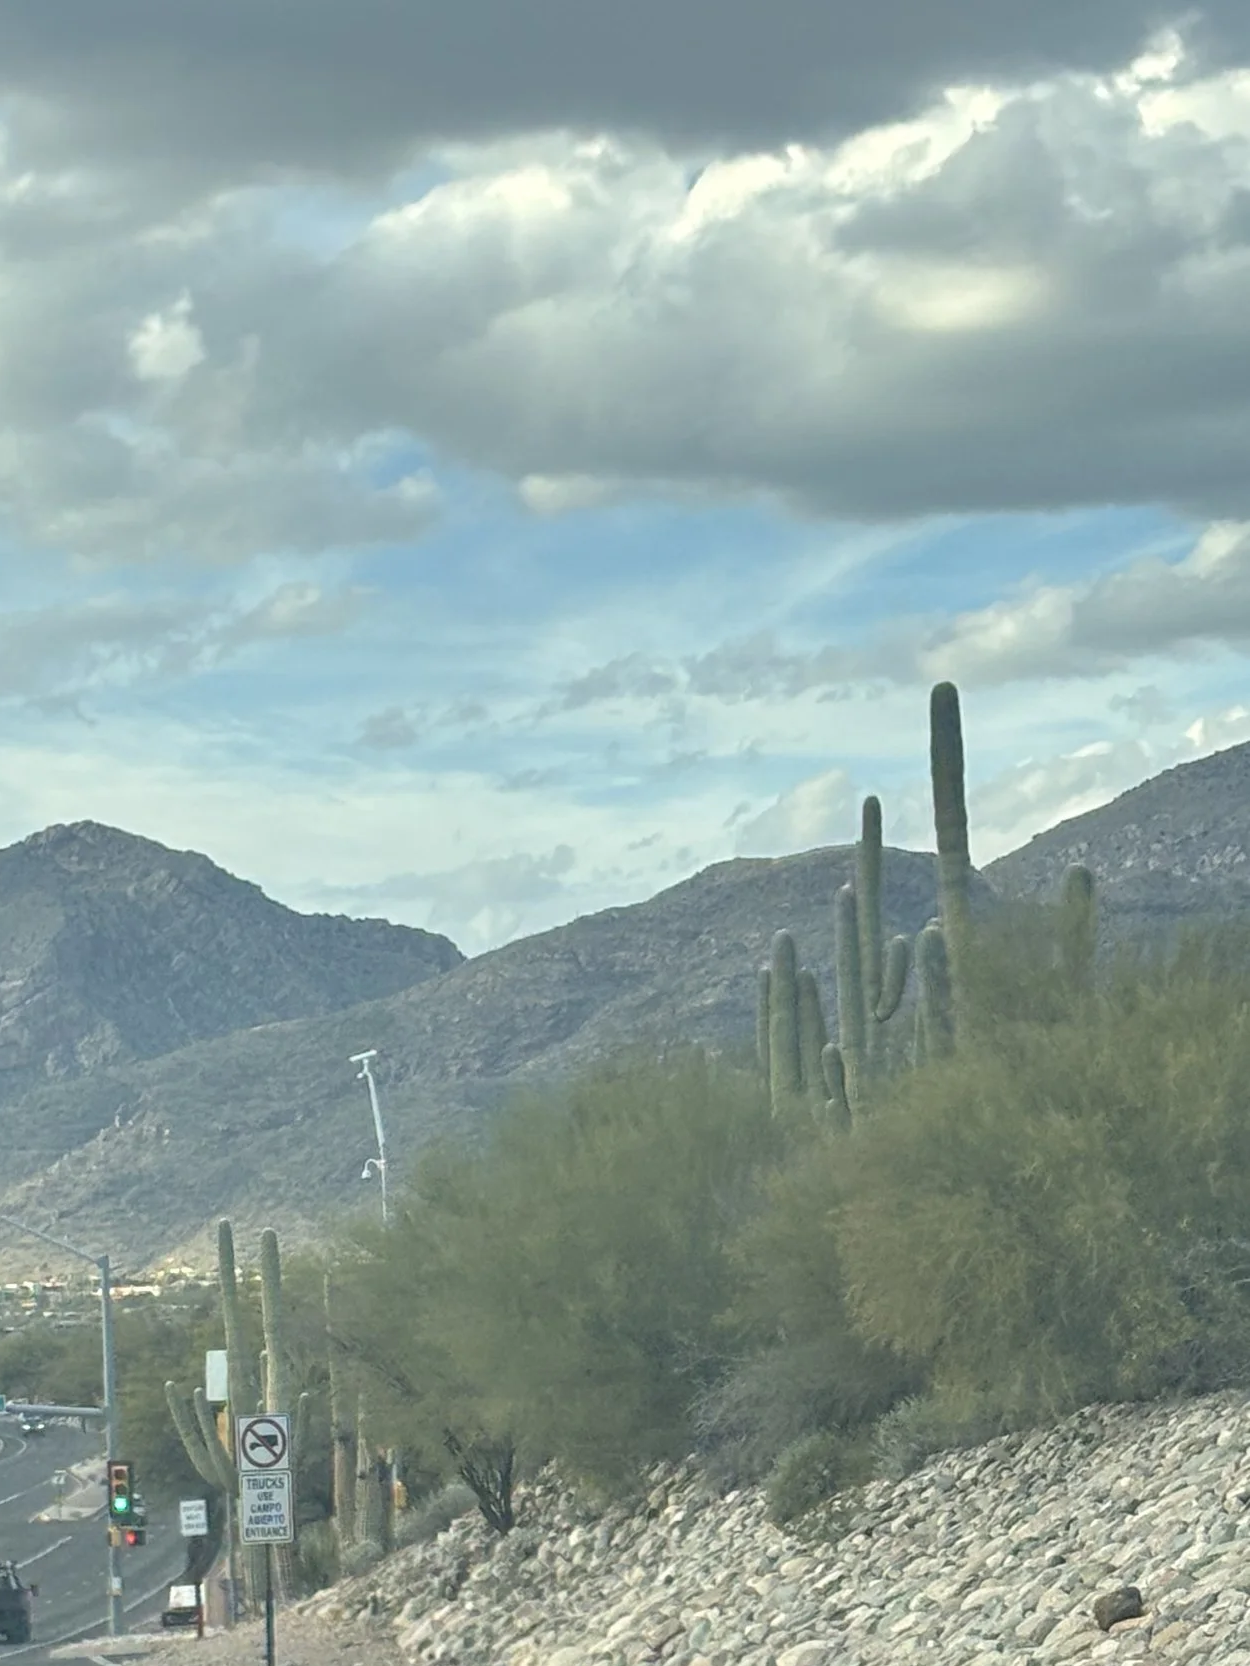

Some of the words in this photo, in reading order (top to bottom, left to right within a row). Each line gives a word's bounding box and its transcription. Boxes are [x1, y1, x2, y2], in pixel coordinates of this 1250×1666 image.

[246, 1477, 285, 1490] TRUCKS
[257, 1491, 274, 1501] USE
[250, 1502, 282, 1513] CAMPO
[248, 1514, 285, 1525] ABIERTO
[245, 1526, 287, 1538] ENTRANCE
